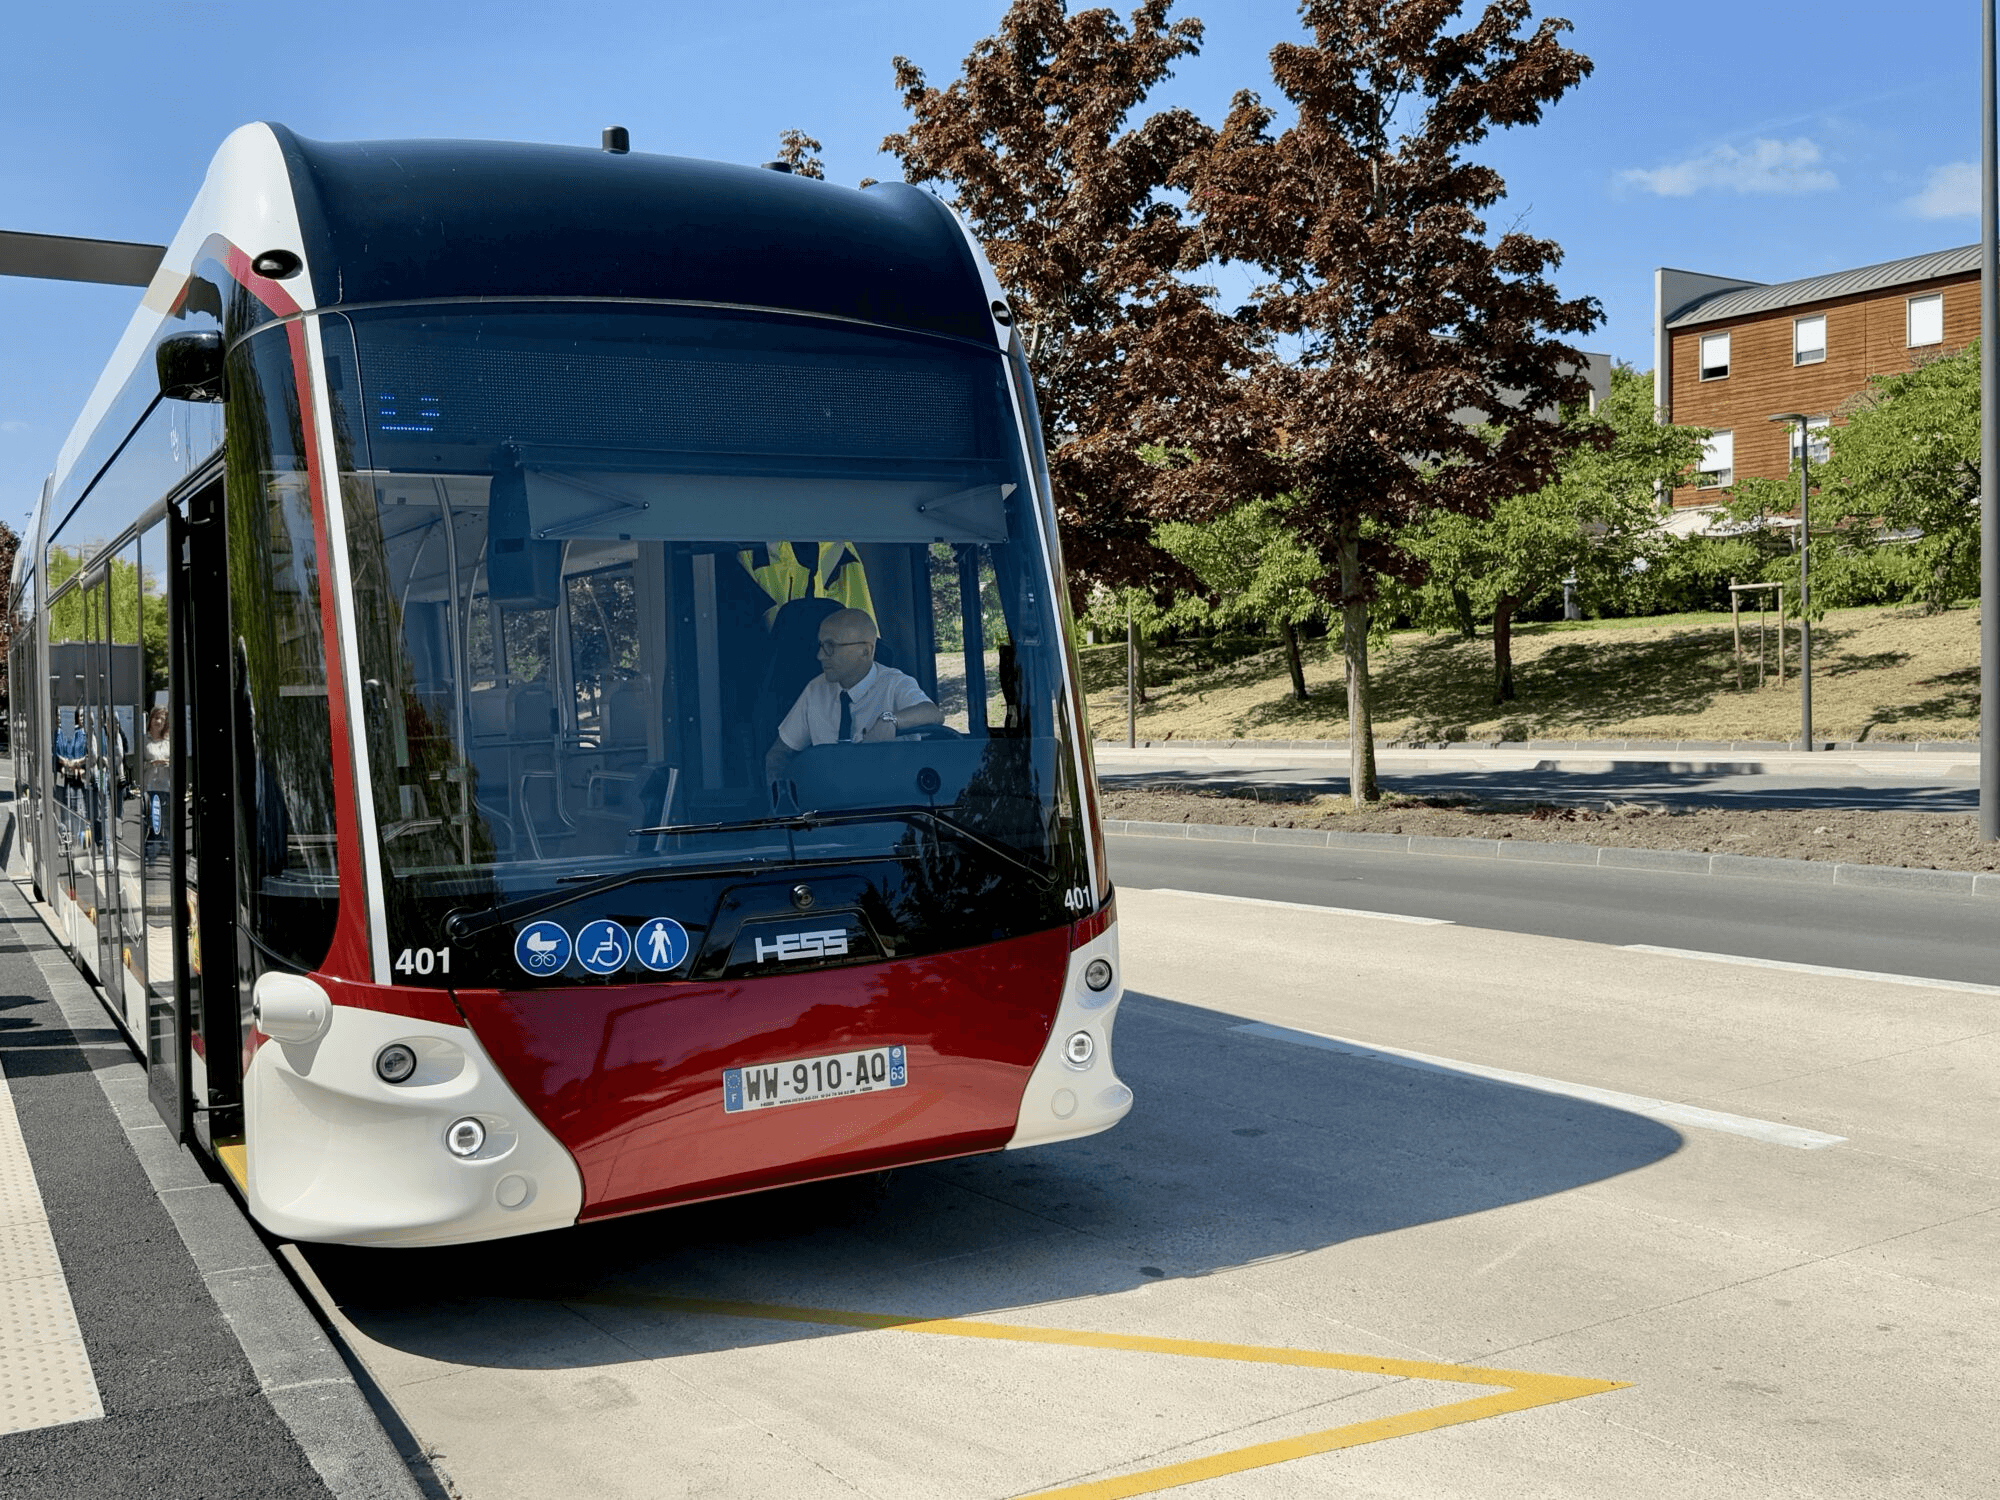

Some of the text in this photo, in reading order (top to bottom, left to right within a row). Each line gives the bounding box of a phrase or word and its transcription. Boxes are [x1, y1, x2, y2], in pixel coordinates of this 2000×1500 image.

[1064, 885, 1091, 911] 401
[395, 946, 450, 975] 401
[755, 929, 848, 963] HESS
[731, 1093, 738, 1103] F
[745, 1052, 886, 1102] WW-910-AQ
[891, 1066, 904, 1080] 63
